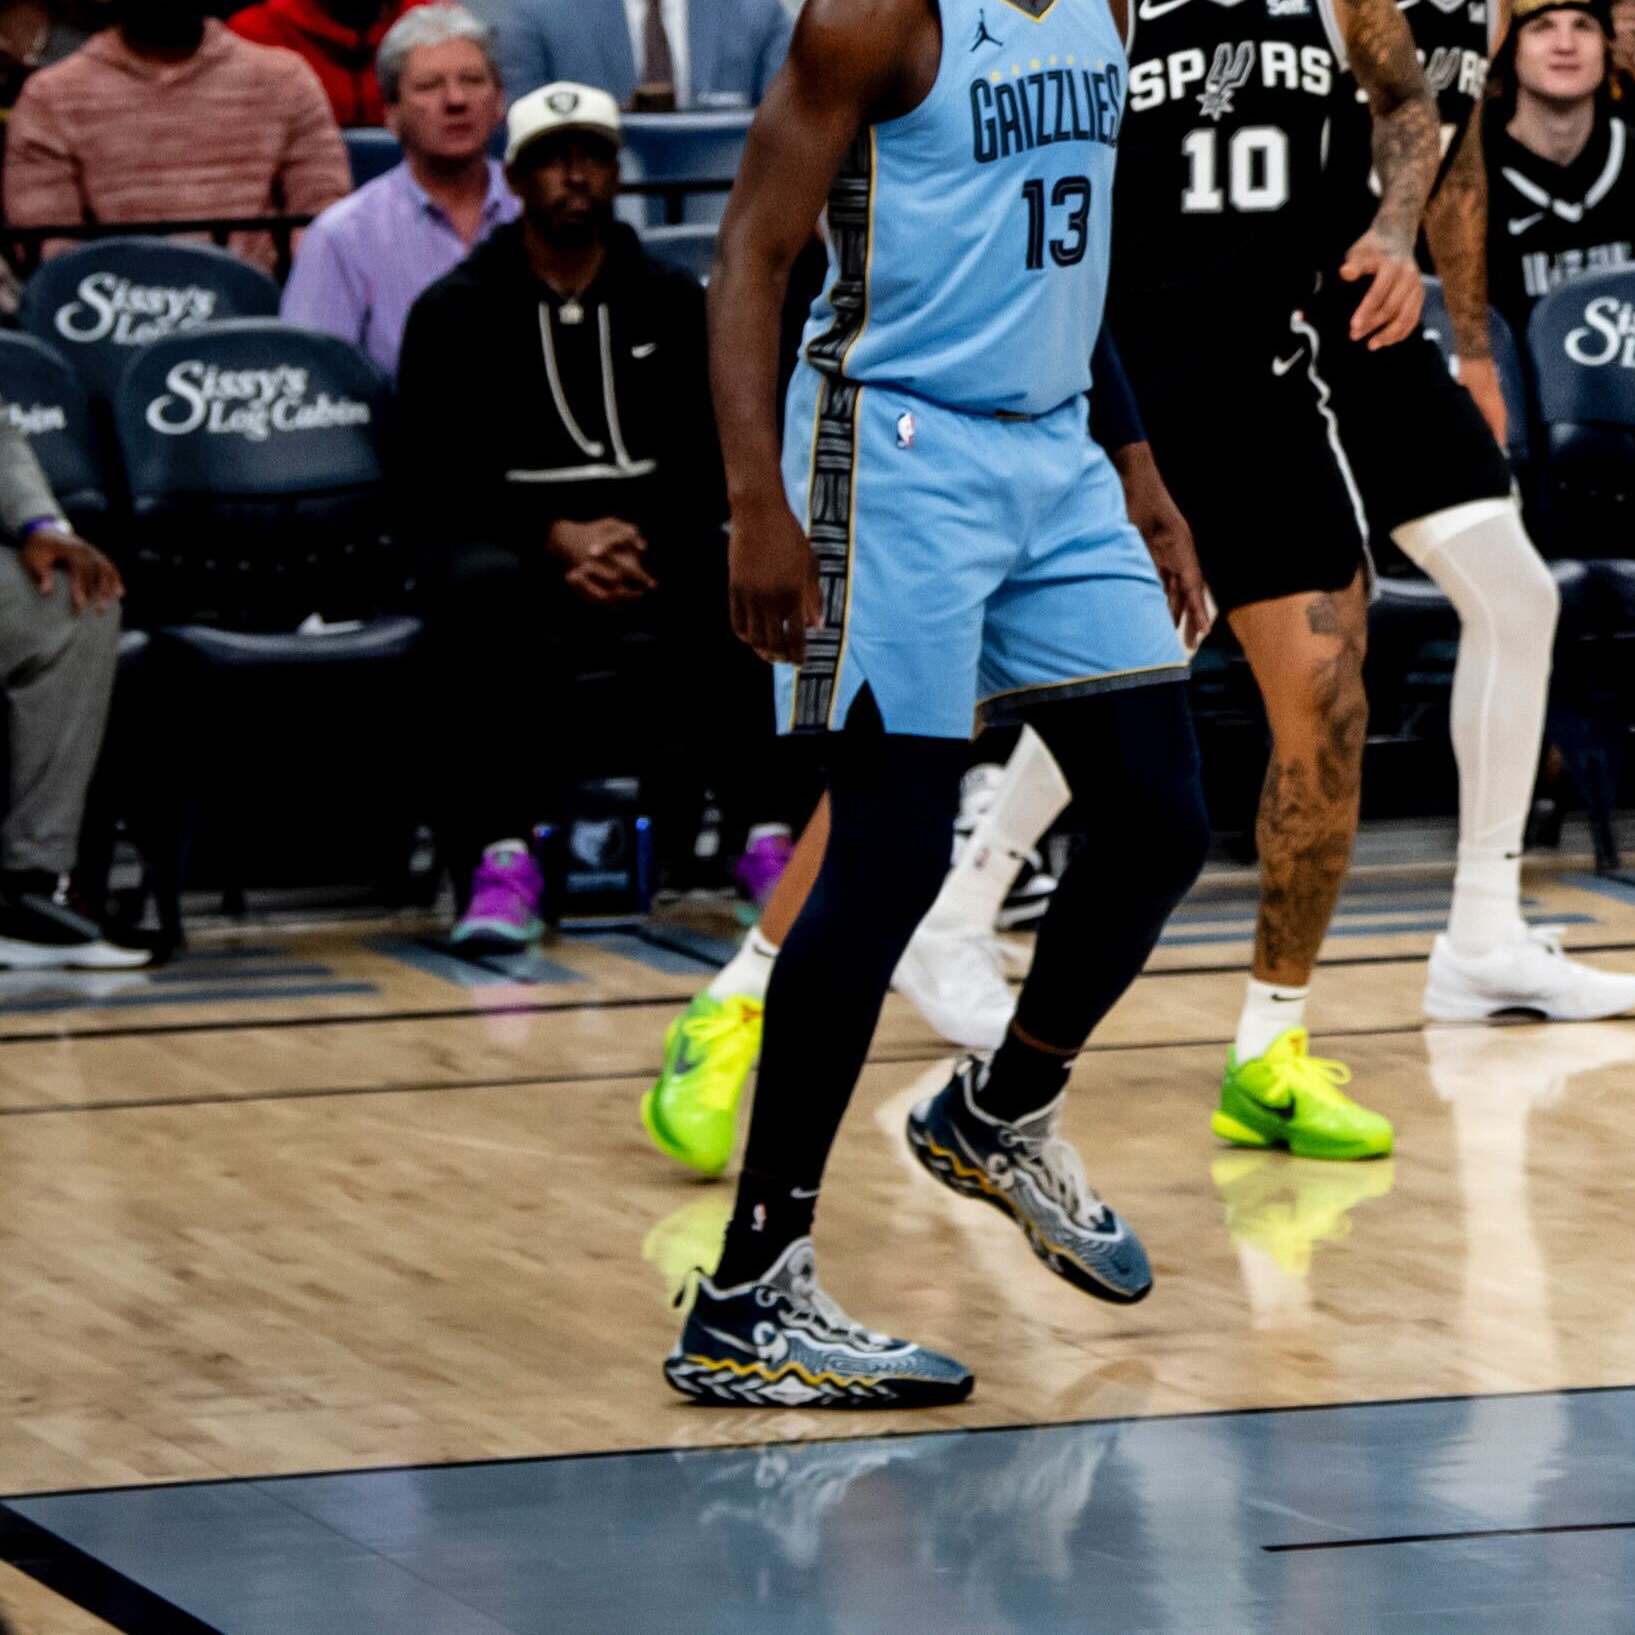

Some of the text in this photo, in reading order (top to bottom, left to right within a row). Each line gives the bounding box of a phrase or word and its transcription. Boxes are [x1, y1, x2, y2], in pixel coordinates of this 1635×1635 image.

[969, 63, 1121, 164] GRIZZLIES
[1181, 125, 1290, 214] 10
[1021, 175, 1091, 271] 13
